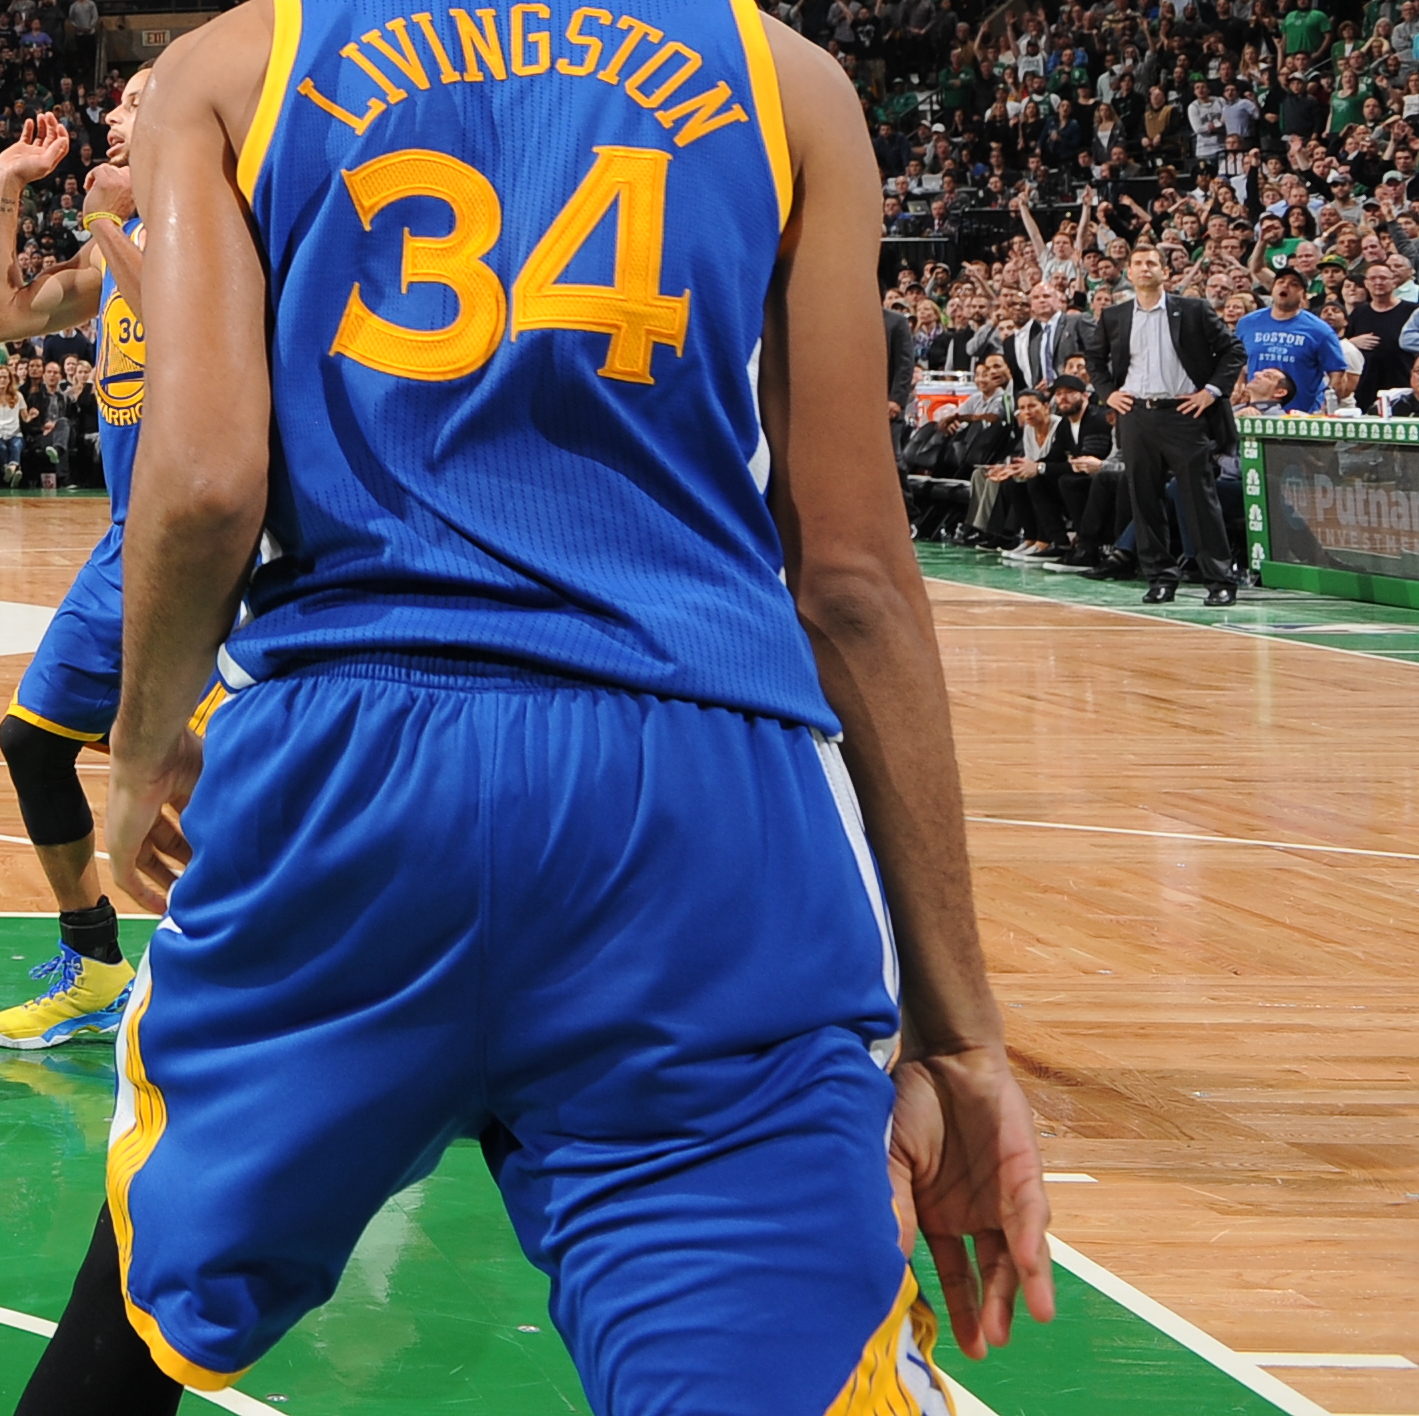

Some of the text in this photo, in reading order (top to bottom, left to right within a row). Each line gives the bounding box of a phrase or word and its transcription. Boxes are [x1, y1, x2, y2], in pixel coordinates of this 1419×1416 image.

[296, 2, 750, 150] LIVINGSTON
[328, 145, 692, 385] 34
[118, 317, 145, 344] 30
[1254, 331, 1305, 347] BOSTON
